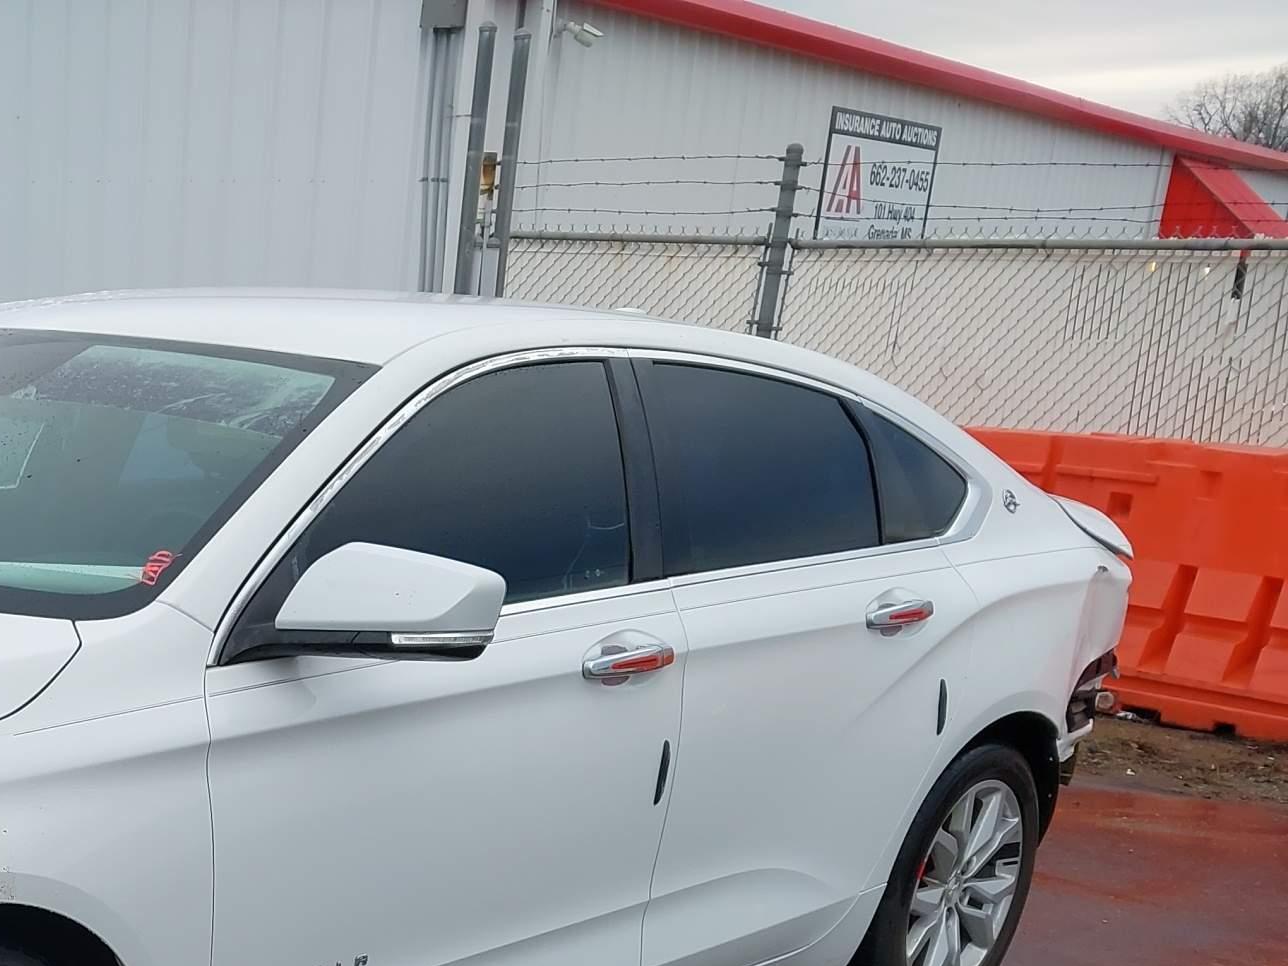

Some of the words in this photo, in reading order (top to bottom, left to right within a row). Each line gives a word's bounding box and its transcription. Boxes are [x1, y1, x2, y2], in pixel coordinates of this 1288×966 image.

[835, 111, 880, 136] INSURANCE
[879, 120, 902, 140] AUTO
[902, 125, 938, 147] AUCTIONS
[869, 163, 930, 192] 662-237-0455
[873, 203, 886, 220] 101
[887, 204, 901, 225] Hwy
[903, 206, 916, 222] 404
